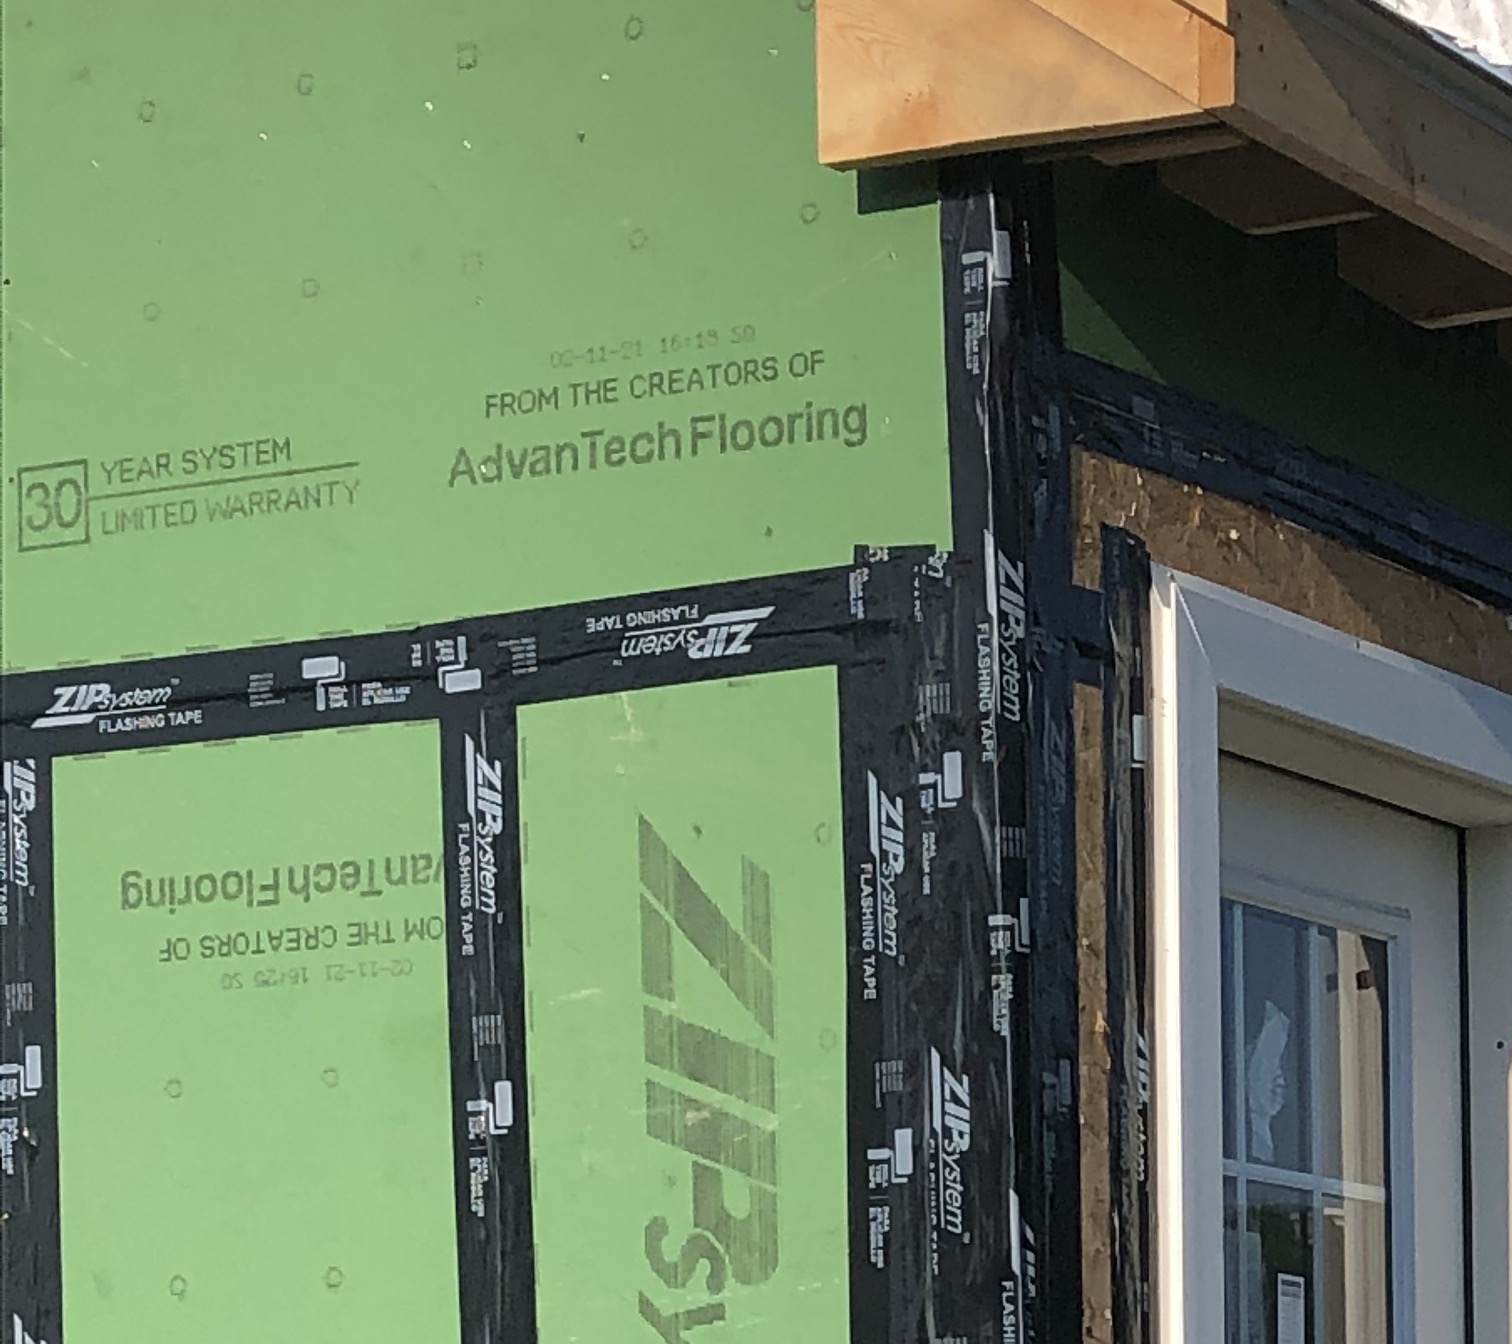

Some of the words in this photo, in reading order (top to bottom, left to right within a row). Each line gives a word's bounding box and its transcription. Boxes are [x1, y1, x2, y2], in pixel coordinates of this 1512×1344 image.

[484, 385, 561, 420] FROM
[568, 377, 619, 409] THE
[629, 355, 779, 400] CREATORS
[788, 350, 825, 379] OF
[101, 453, 173, 486] YEAR
[182, 436, 292, 476] SYSTEM
[24, 476, 84, 533] 30
[100, 497, 198, 536] LIMITED
[205, 479, 361, 524] WARRANTY
[585, 614, 623, 634] TAPE
[625, 604, 700, 629] FLASHING
[976, 621, 993, 713] FLASHING
[99, 714, 166, 734] FLASHING
[168, 709, 204, 728] TAPE
[458, 822, 472, 909] FLASHING
[860, 862, 876, 952] FLASHING
[158, 936, 192, 963] OF
[200, 925, 339, 959] CREATORS
[347, 919, 396, 948] THE
[461, 910, 476, 957] TAPE
[861, 953, 877, 1001] TAPE
